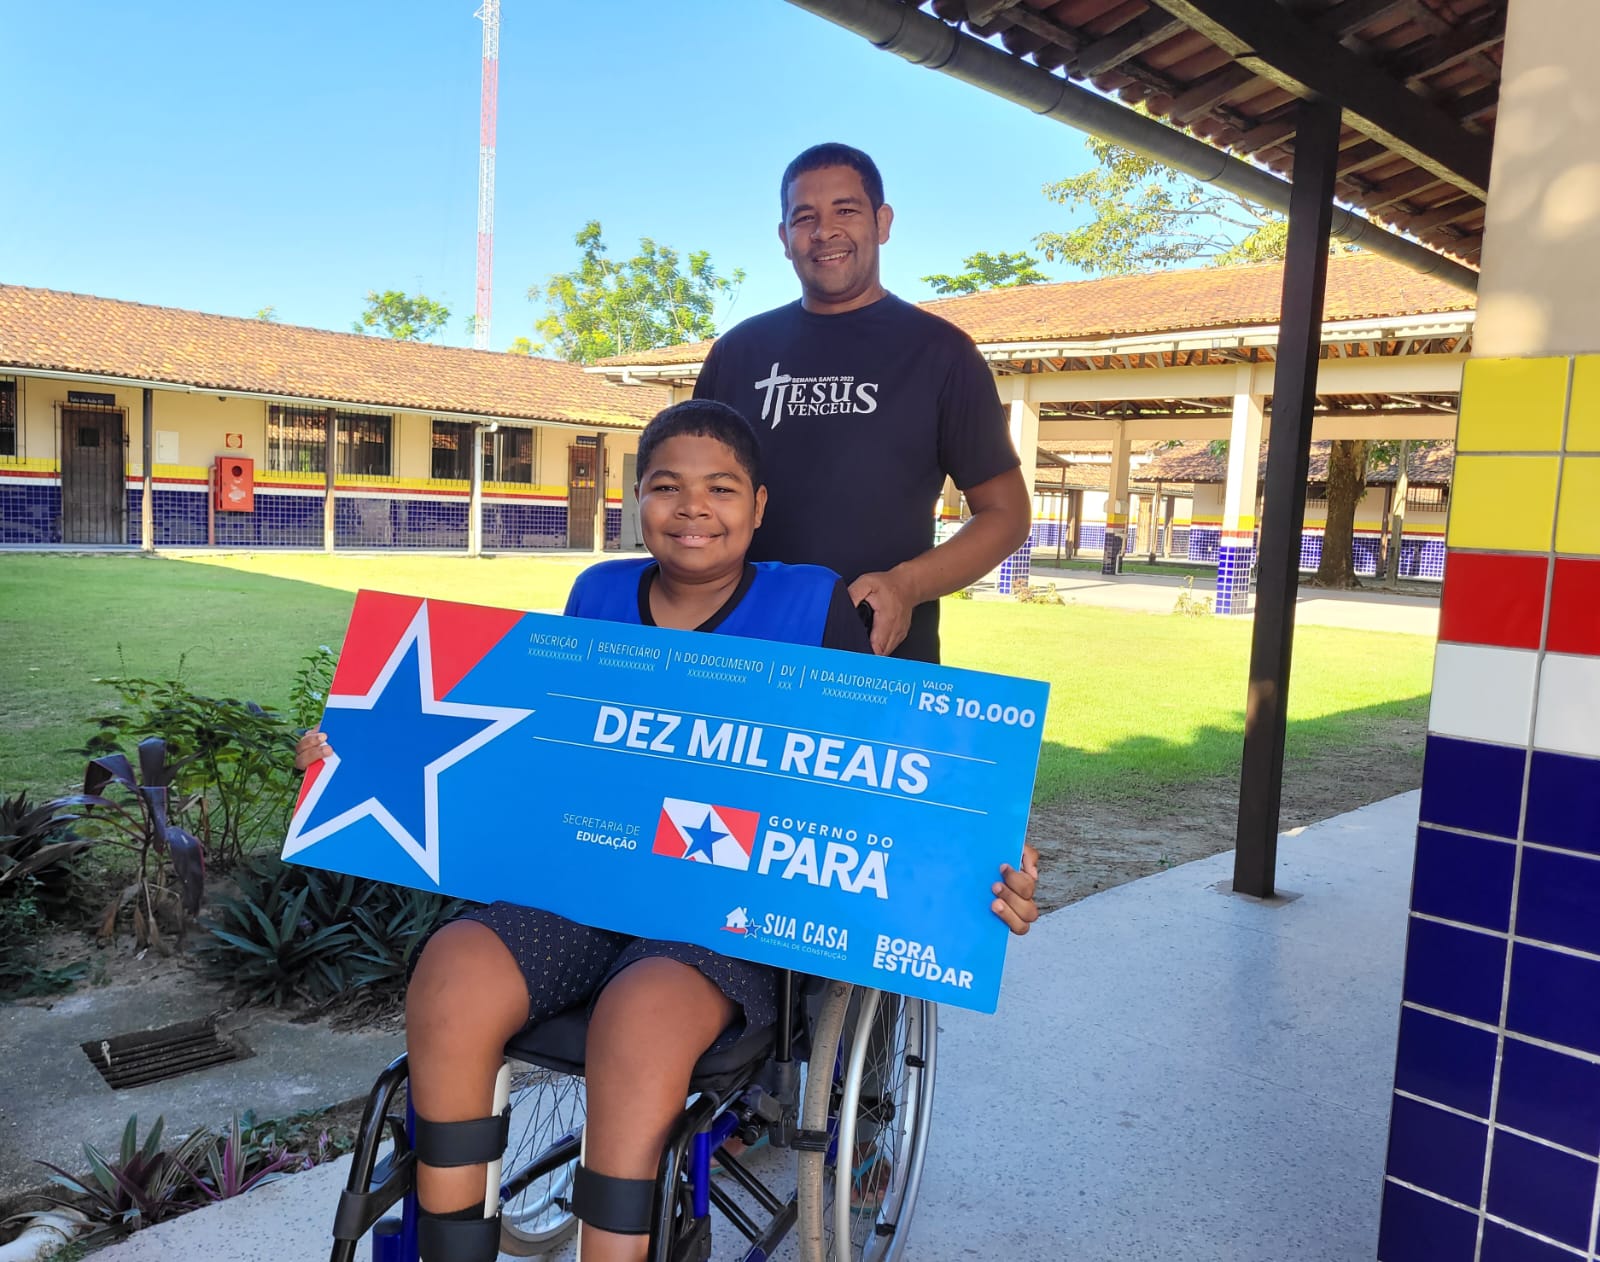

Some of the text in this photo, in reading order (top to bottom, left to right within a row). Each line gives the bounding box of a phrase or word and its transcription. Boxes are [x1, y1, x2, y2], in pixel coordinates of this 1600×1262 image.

[771, 382, 879, 430] JESUS
[529, 632, 578, 650] INSCRIÇÃO
[598, 641, 660, 660] BENEFICIÁRIO
[683, 652, 699, 664] DO
[700, 654, 764, 673] DOCUMENTO
[781, 665, 796, 676] DV
[820, 670, 835, 682] DA
[837, 672, 911, 695] AUTORIZAÇÃO
[922, 680, 954, 692] VALOR
[918, 692, 1036, 728] R$ 10.000
[593, 705, 931, 795] DEZ MIL REAIS
[562, 813, 640, 836] SECRETARIA DE
[768, 815, 893, 849] GOVERNO DO
[576, 830, 637, 850] EDUCAÇÃO
[757, 830, 889, 899] PARÁ
[760, 937, 790, 949] MATERIAL
[791, 943, 801, 951] DE
[762, 913, 848, 951] SUA CASA
[876, 934, 937, 963] BORA
[872, 952, 974, 990] ESTUDAR
